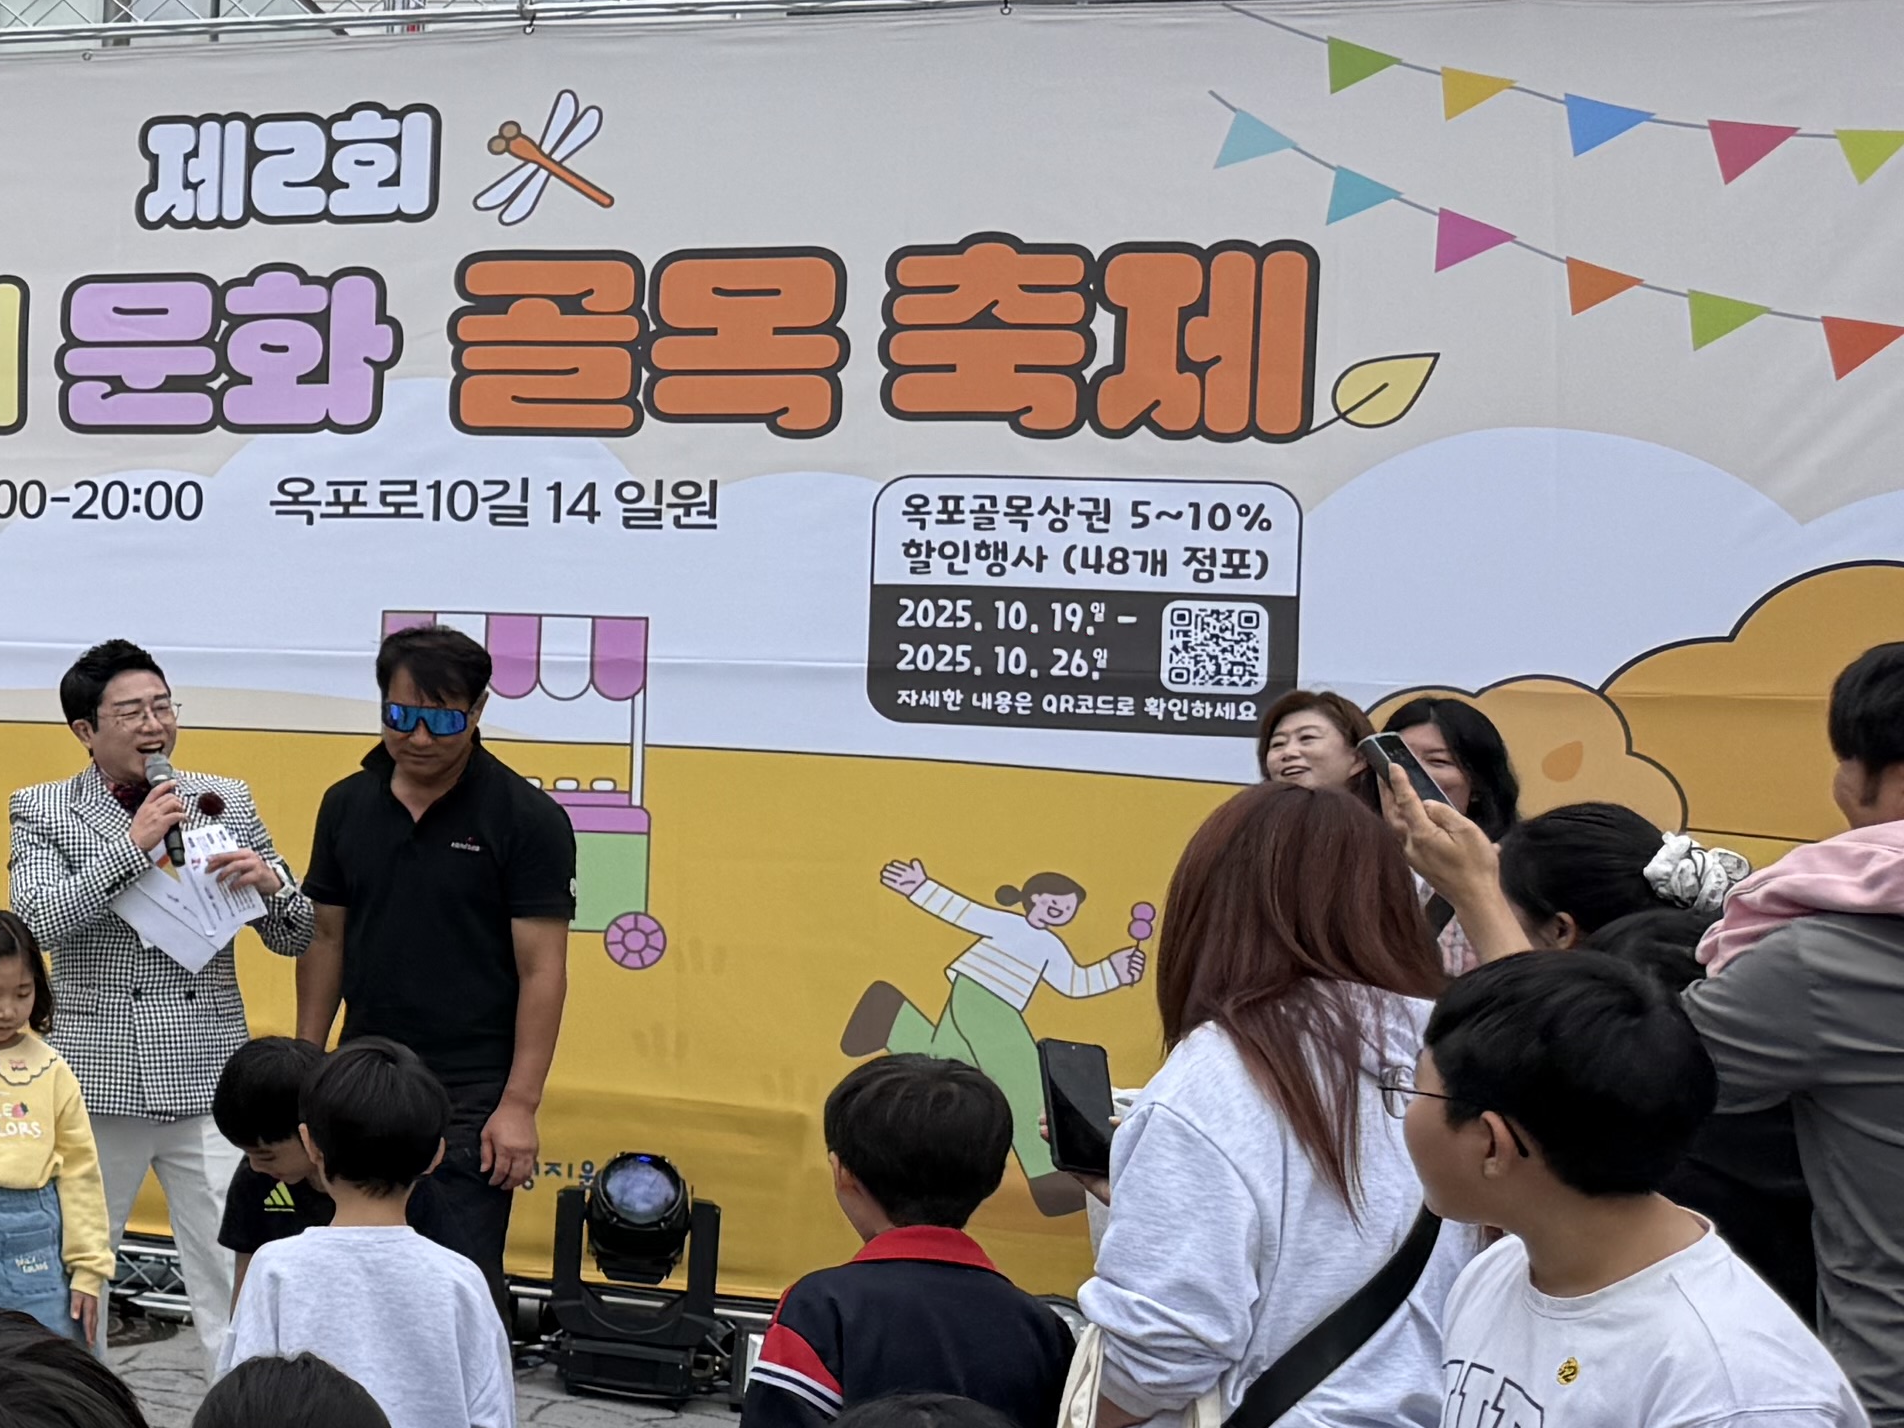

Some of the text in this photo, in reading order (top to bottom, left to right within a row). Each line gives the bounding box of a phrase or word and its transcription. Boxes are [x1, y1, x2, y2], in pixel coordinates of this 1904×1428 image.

[137, 101, 442, 230] 제2회
[56, 263, 404, 435] 문화
[447, 245, 850, 439] 골목
[878, 231, 1320, 443] 축제
[269, 476, 531, 529] 옥포로10길
[546, 483, 599, 525] 14
[613, 479, 720, 532] 일원
[901, 493, 1273, 534] 옥포골목상권 5~10%
[901, 539, 1269, 583] 할인행사 (48개 점포)
[897, 597, 983, 632] 2025.
[994, 600, 1039, 634] 10.
[897, 643, 983, 676] 2025.
[994, 646, 1039, 679] 10.
[897, 688, 1258, 722] 자세한 내용은 QR코드로 확인하세요
